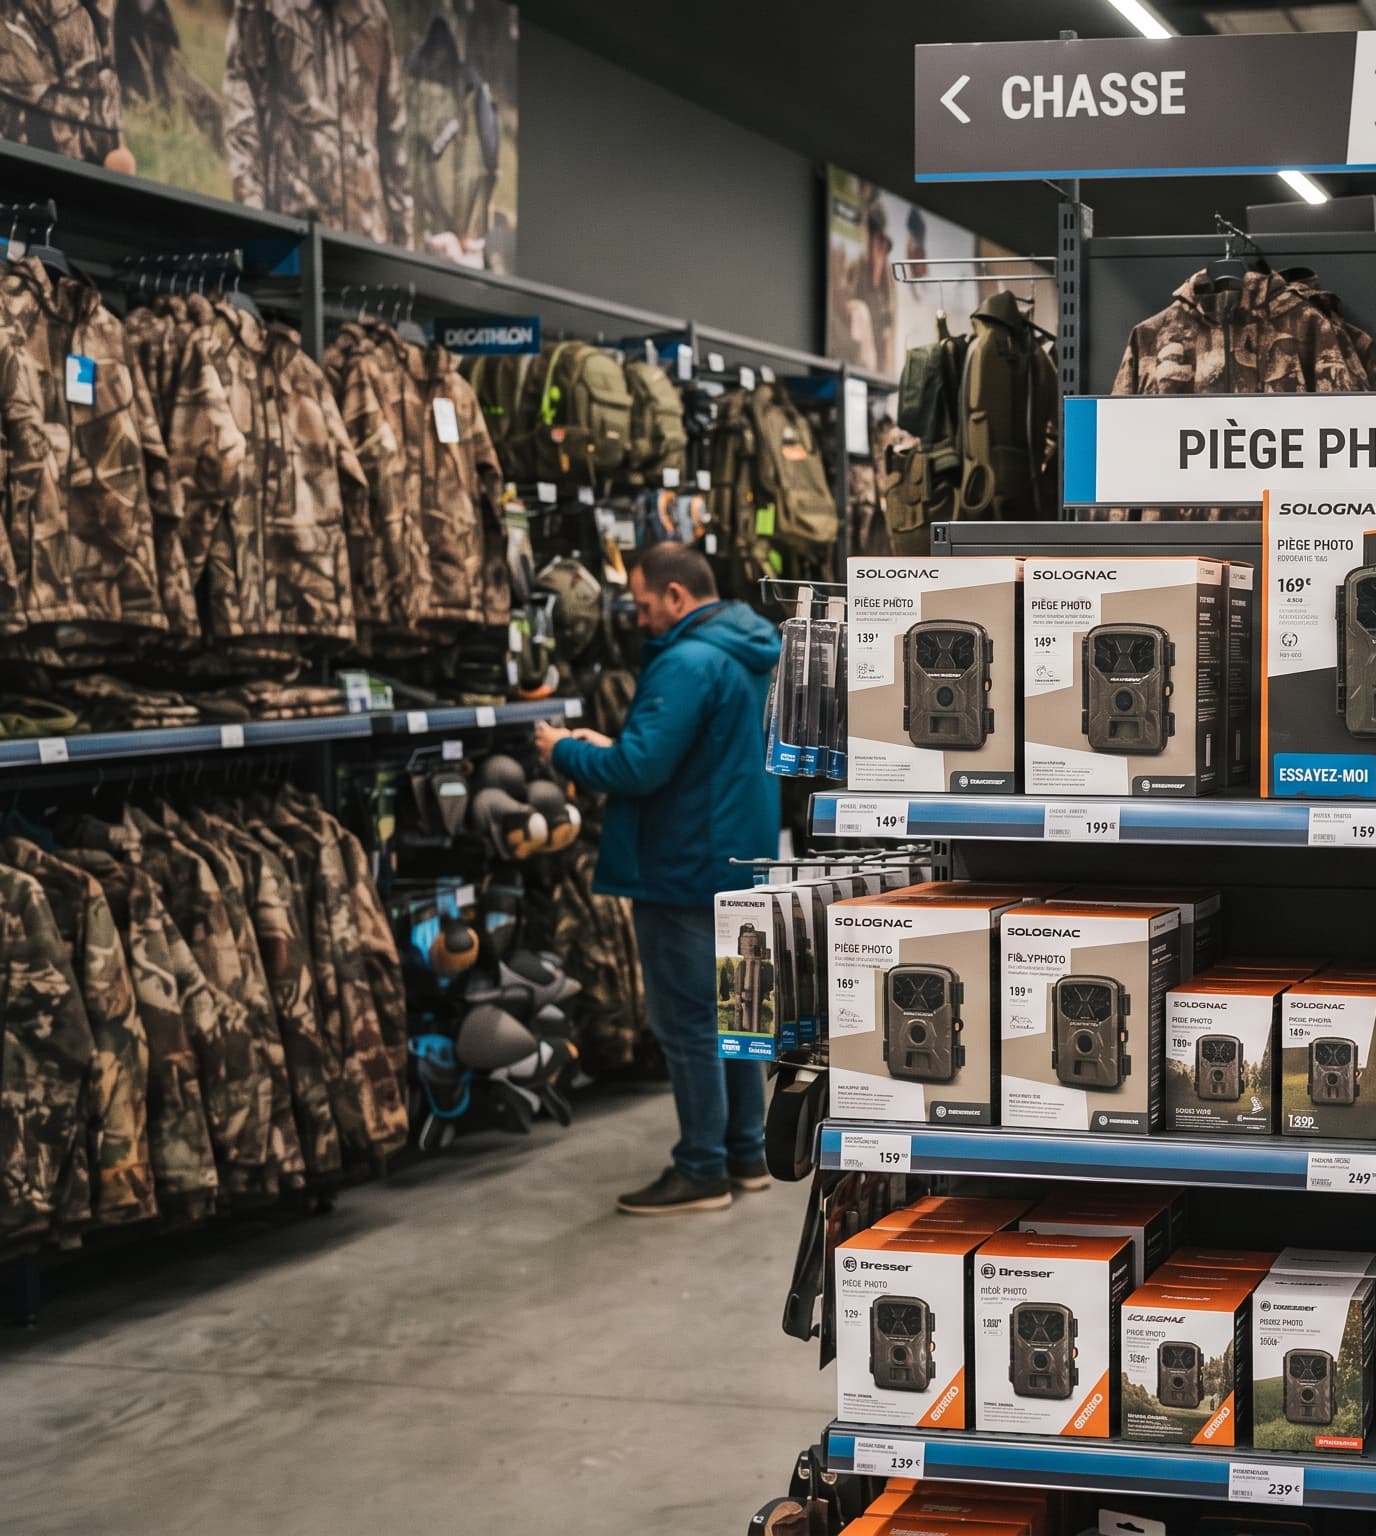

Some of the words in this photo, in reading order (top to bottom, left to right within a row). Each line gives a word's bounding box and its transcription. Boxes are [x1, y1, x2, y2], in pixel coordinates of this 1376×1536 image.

[1001, 70, 1187, 121] CHASSE
[445, 327, 533, 347] DECATHLON
[1179, 418, 1304, 470] PIÈGE
[1277, 537, 1311, 551] PIÈGE
[1314, 539, 1353, 551] PHOTO
[856, 569, 940, 579] SOLOGNAC
[1032, 570, 1117, 580] SOLOGNAC
[883, 598, 914, 608] PHOTO
[1060, 600, 1092, 610] PHOTO
[1279, 768, 1368, 783] ESSAYEZ-MOI
[876, 816, 897, 827] 149
[1086, 822, 1108, 833] 199
[1352, 825, 1375, 838] 159
[834, 917, 913, 928] SOLOGNAC
[1007, 927, 1081, 938] SOLOGNAC
[861, 944, 893, 955] PHOTO
[879, 1152, 900, 1163] 159
[1348, 1172, 1371, 1185] 249
[860, 1261, 913, 1272] Bresser
[864, 1280, 888, 1289] PHOTO
[1002, 1287, 1027, 1296] PHOTO
[890, 1457, 913, 1469] 139
[1268, 1483, 1293, 1496] 239
[1294, 1485, 1301, 1493] €
